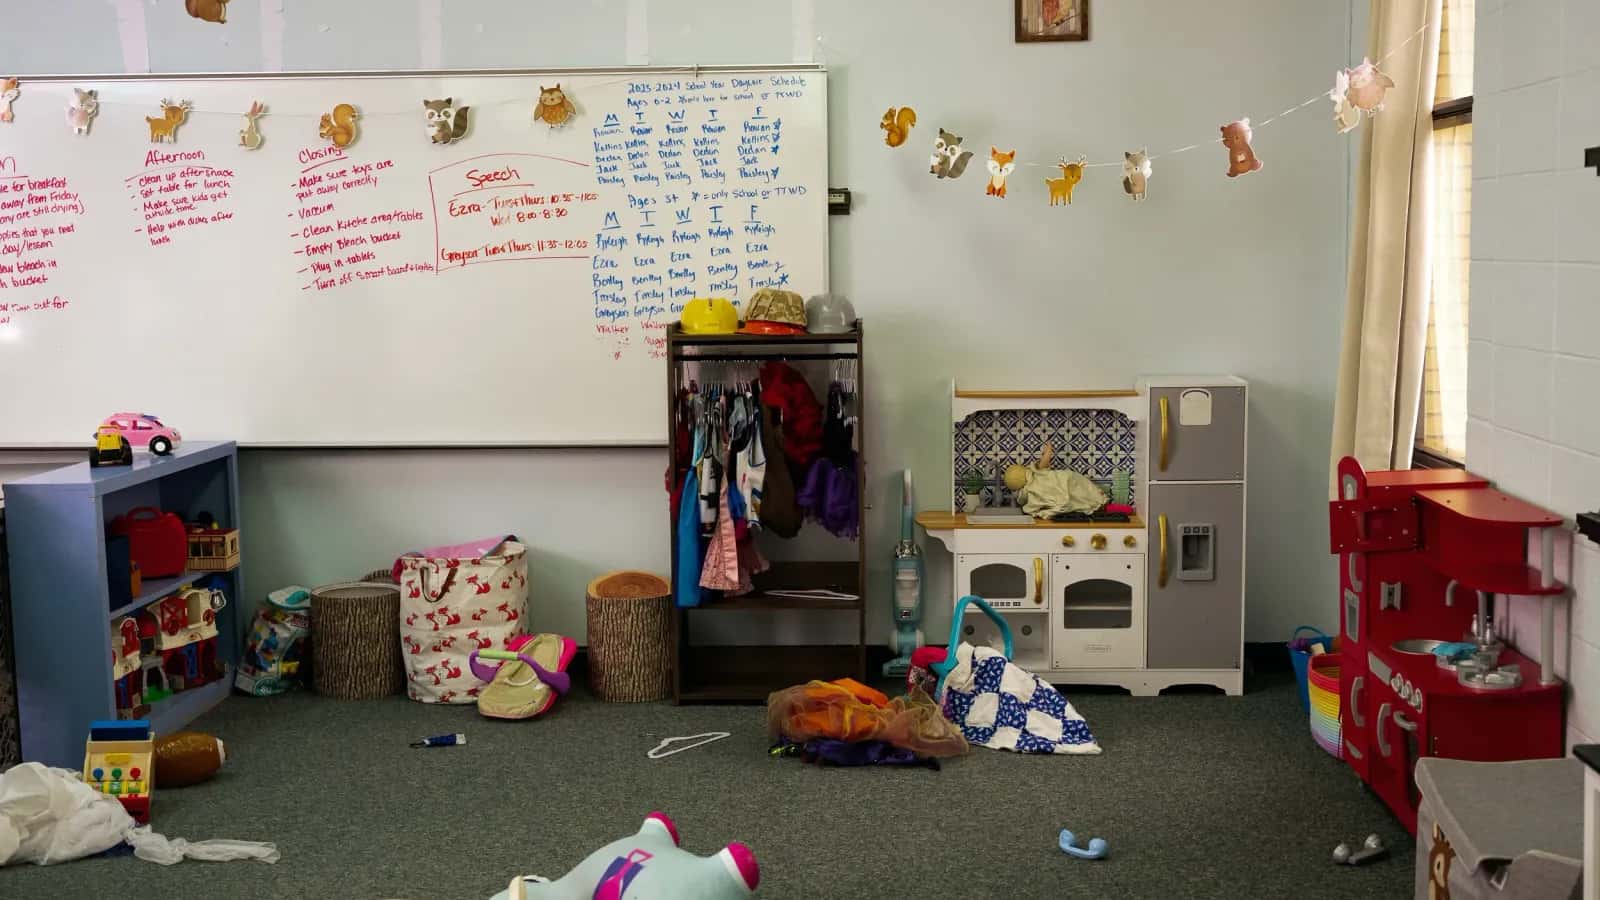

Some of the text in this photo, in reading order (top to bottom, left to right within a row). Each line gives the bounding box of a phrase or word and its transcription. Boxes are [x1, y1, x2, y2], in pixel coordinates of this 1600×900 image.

[627, 97, 648, 110] Ages
[604, 112, 619, 123] M
[668, 108, 685, 120] W
[144, 149, 206, 167] Afternoon
[298, 144, 343, 164] Closing
[165, 172, 177, 183] up
[180, 167, 204, 179] after
[205, 168, 234, 178] snack
[298, 159, 395, 189] Make sure toys are
[465, 166, 521, 189] Speech
[12, 180, 25, 192] for
[27, 176, 67, 191] breakfast
[158, 182, 180, 194] table
[184, 180, 198, 190] for
[204, 180, 231, 190] lunch
[316, 183, 339, 197] away
[1, 189, 79, 211] away from Friday
[143, 200, 168, 212] Make
[192, 192, 209, 203] kids
[210, 190, 228, 202] get
[627, 193, 657, 209] Ages
[16, 211, 30, 220] are
[32, 206, 50, 217] still
[145, 207, 174, 221] outside
[604, 211, 619, 226] M
[675, 206, 690, 221] W
[22, 227, 37, 239] that
[41, 227, 55, 239] you
[58, 223, 75, 235] need
[147, 223, 165, 236] Help
[211, 210, 234, 223] after
[305, 241, 333, 257] Empty
[370, 230, 402, 245] bucket
[633, 256, 656, 267] Ezra
[670, 251, 692, 263] Ezra
[710, 247, 731, 257] Ezra
[745, 241, 769, 254] Ezra
[17, 259, 45, 273] bleach
[311, 250, 376, 275] Plug in tablets
[11, 273, 48, 288] bucket
[313, 278, 336, 292] Turn
[339, 271, 353, 288] off
[52, 295, 69, 309] for
